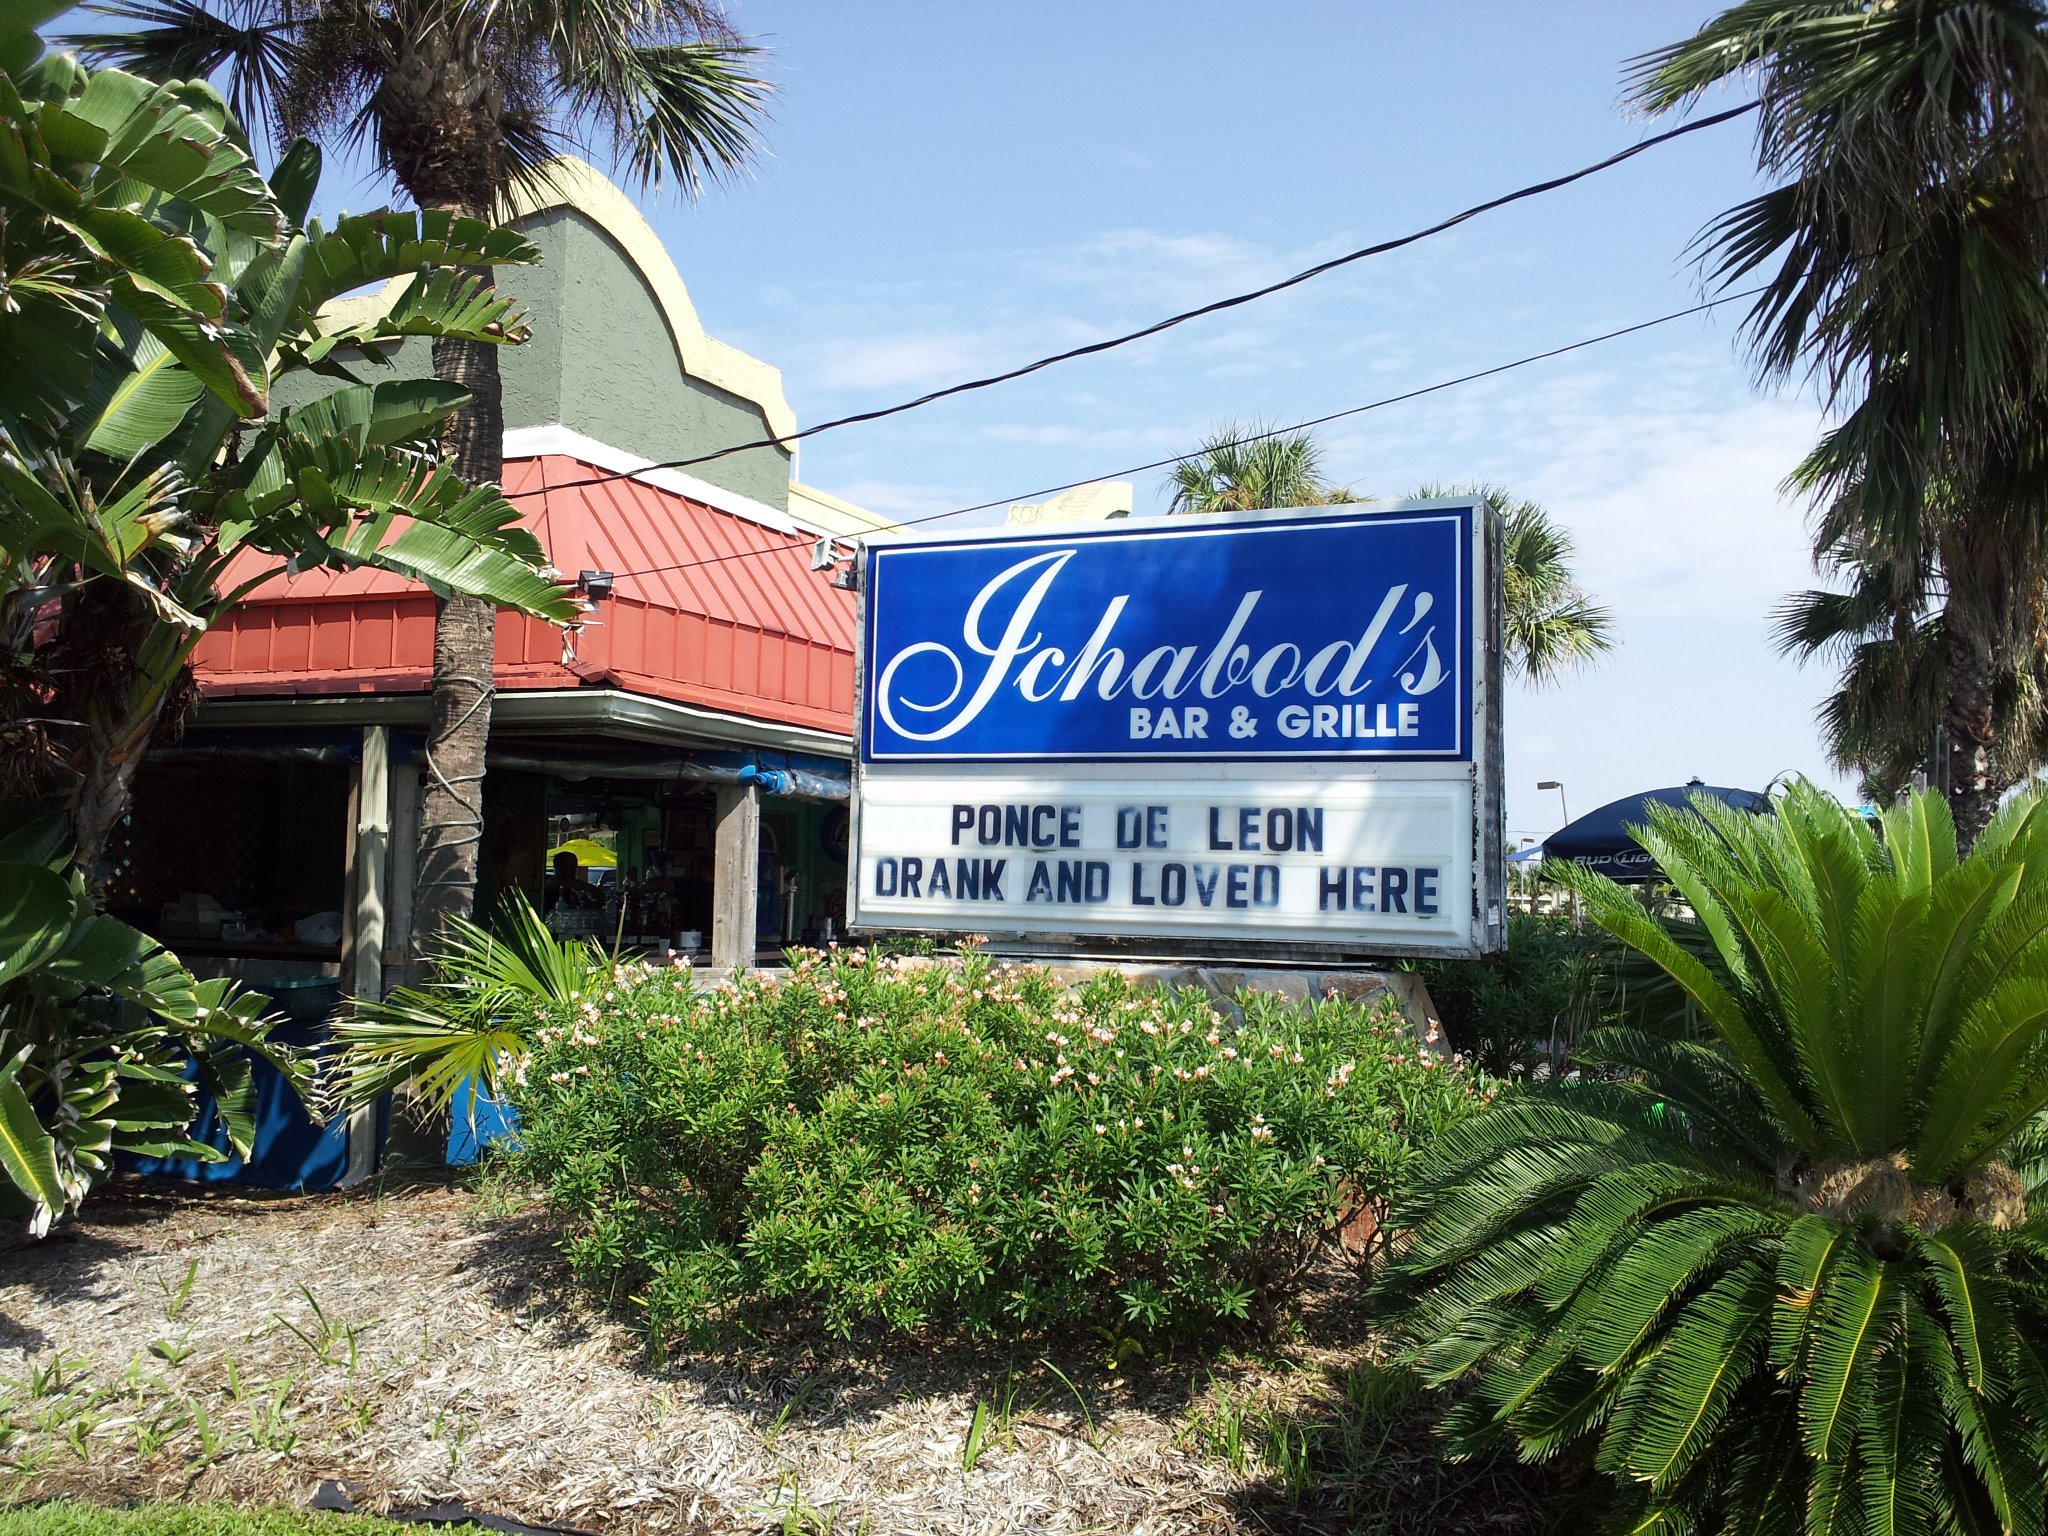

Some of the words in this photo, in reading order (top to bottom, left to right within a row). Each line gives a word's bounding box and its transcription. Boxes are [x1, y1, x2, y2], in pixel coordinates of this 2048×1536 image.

[878, 549, 1450, 742] Ichabod's
[1129, 706, 1208, 739] BAR
[1228, 705, 1257, 739] &
[1277, 703, 1419, 738] GRILLE
[951, 804, 1081, 848] PONCE
[1116, 806, 1168, 849] DE
[1209, 806, 1324, 852] LEON
[1573, 855, 1611, 866] BUD
[1620, 854, 1653, 864] LIG
[875, 856, 1006, 901] DRANK
[1026, 860, 1110, 903] AND
[1132, 862, 1280, 908] LOVED
[1319, 866, 1438, 914] HERE
